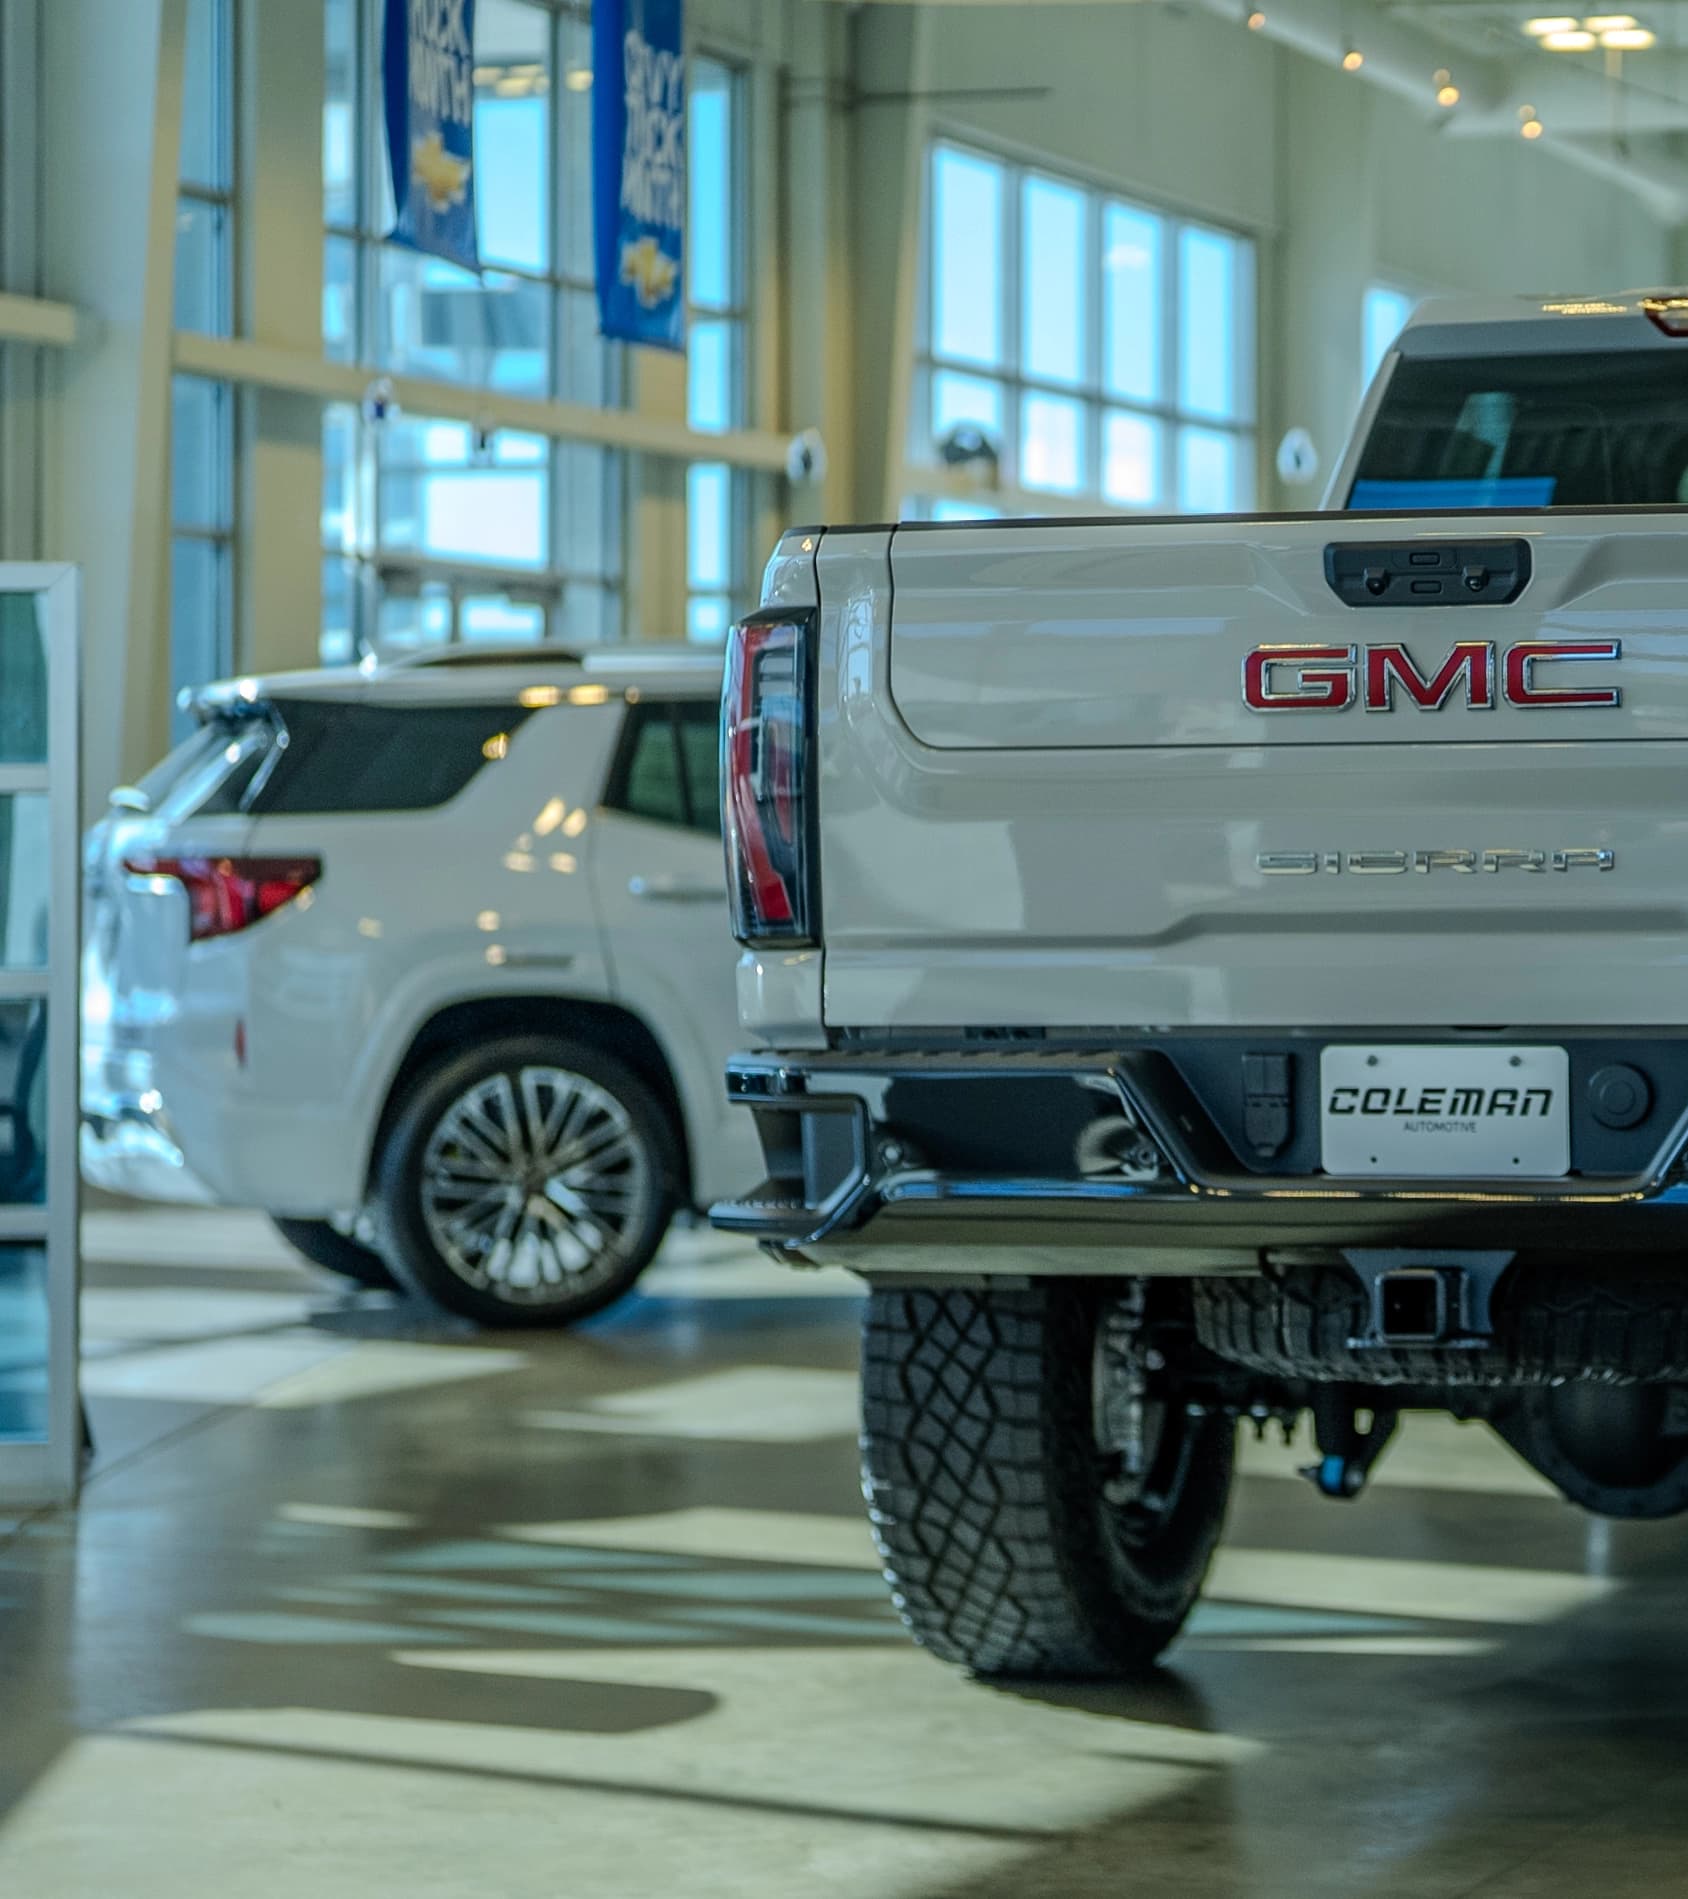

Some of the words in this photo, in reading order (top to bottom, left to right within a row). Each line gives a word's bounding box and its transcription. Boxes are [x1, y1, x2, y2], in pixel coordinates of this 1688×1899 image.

[1241, 638, 1622, 713] GMC
[1256, 848, 1614, 875] SIERRA
[1328, 1087, 1553, 1117] COLEMAN
[1403, 1121, 1477, 1133] AUTOMOTIVE
